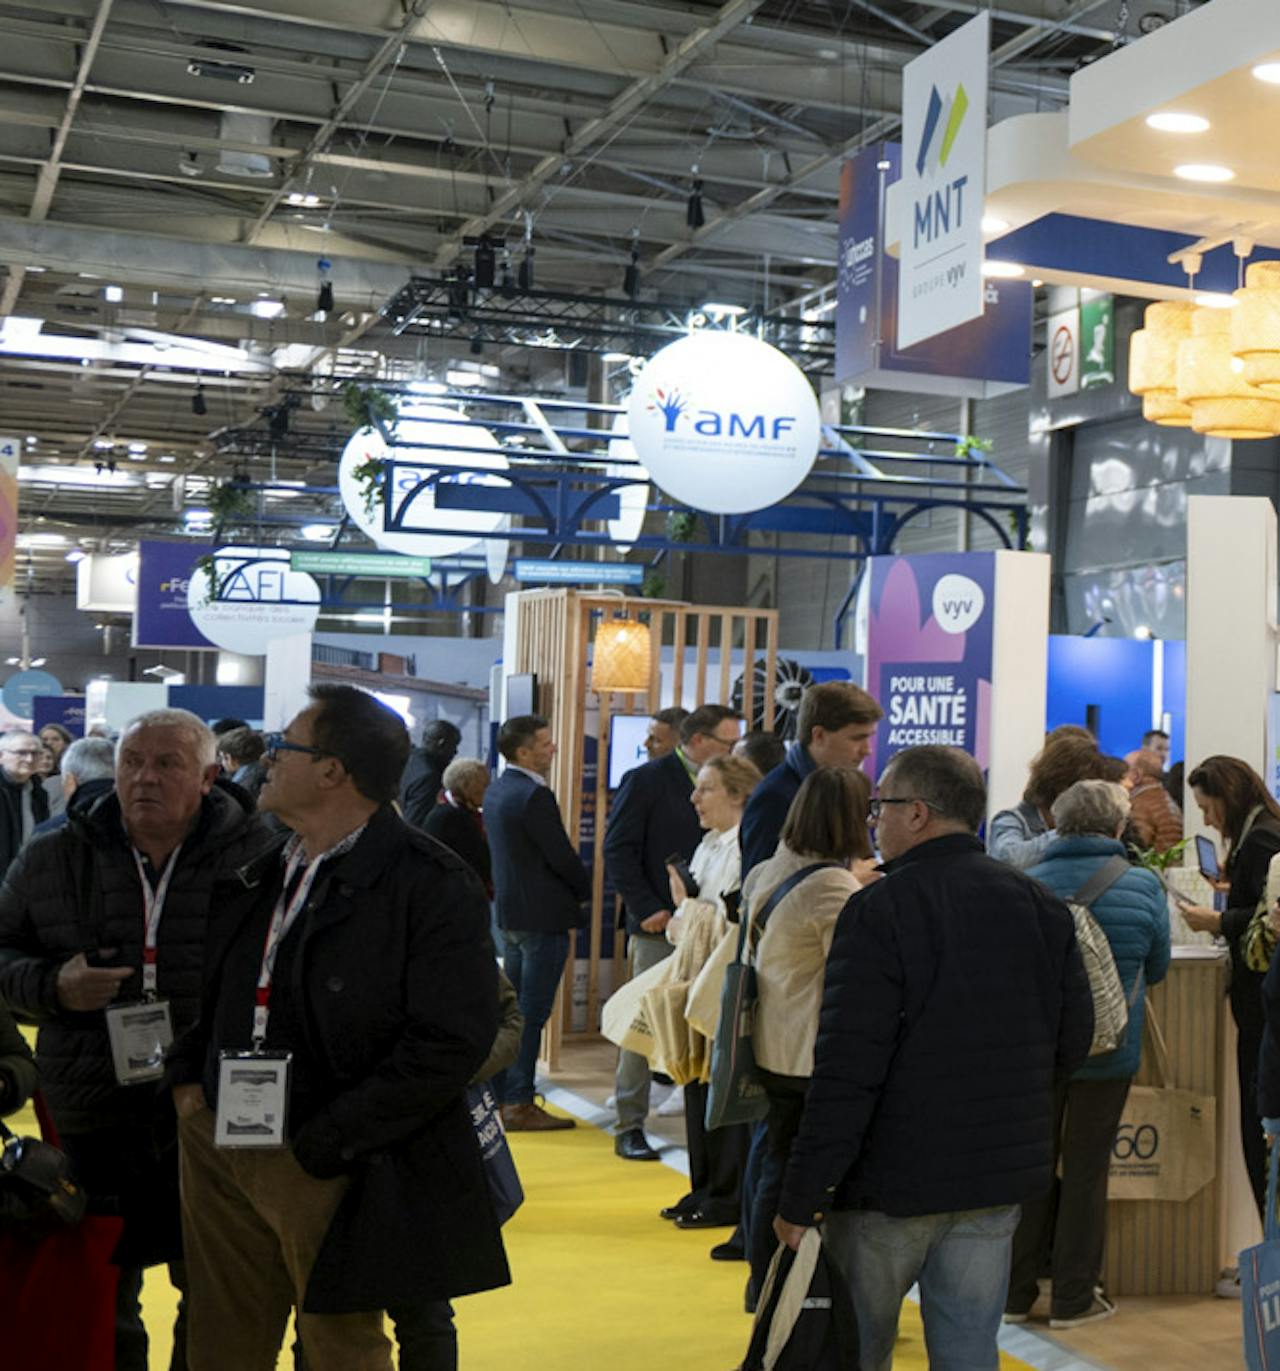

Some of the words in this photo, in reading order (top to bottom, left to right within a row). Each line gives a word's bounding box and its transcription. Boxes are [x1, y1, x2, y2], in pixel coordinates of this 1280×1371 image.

[914, 175, 968, 249] MNT
[947, 261, 967, 288] vyv
[943, 600, 973, 619] vyv
[890, 676, 925, 692] POUR
[928, 676, 954, 692] UNE
[889, 688, 967, 725] SANTÉ
[888, 729, 966, 745] ACCESSIBLE
[1113, 1125, 1158, 1159] 60
